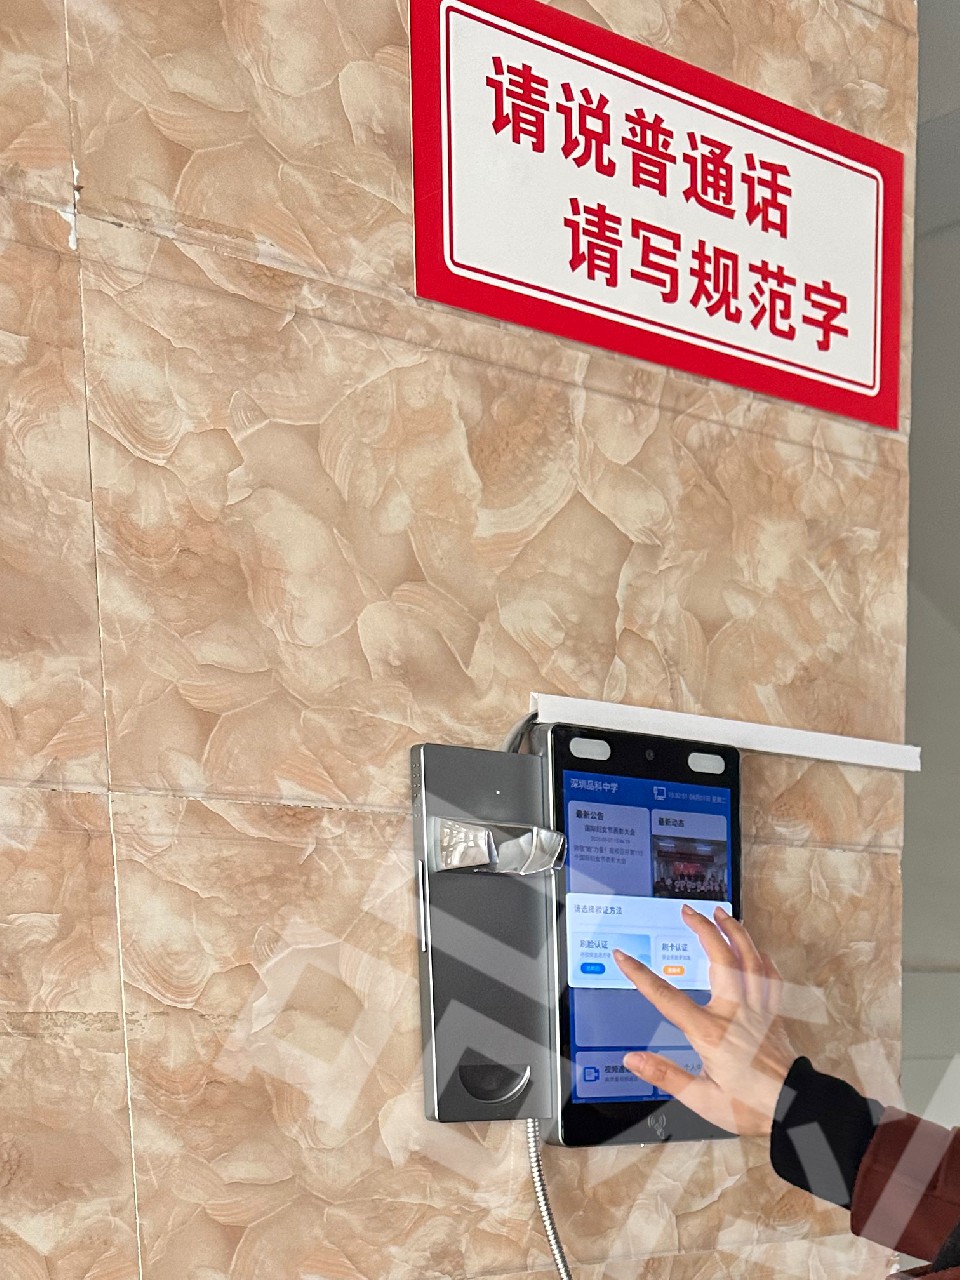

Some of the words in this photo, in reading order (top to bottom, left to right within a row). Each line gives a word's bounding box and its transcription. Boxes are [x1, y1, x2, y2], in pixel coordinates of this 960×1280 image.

[485, 56, 794, 239] 请说普通话
[563, 197, 849, 352] 请写规范字
[576, 809, 604, 821] 最新公告
[658, 816, 685, 828] 最新动态
